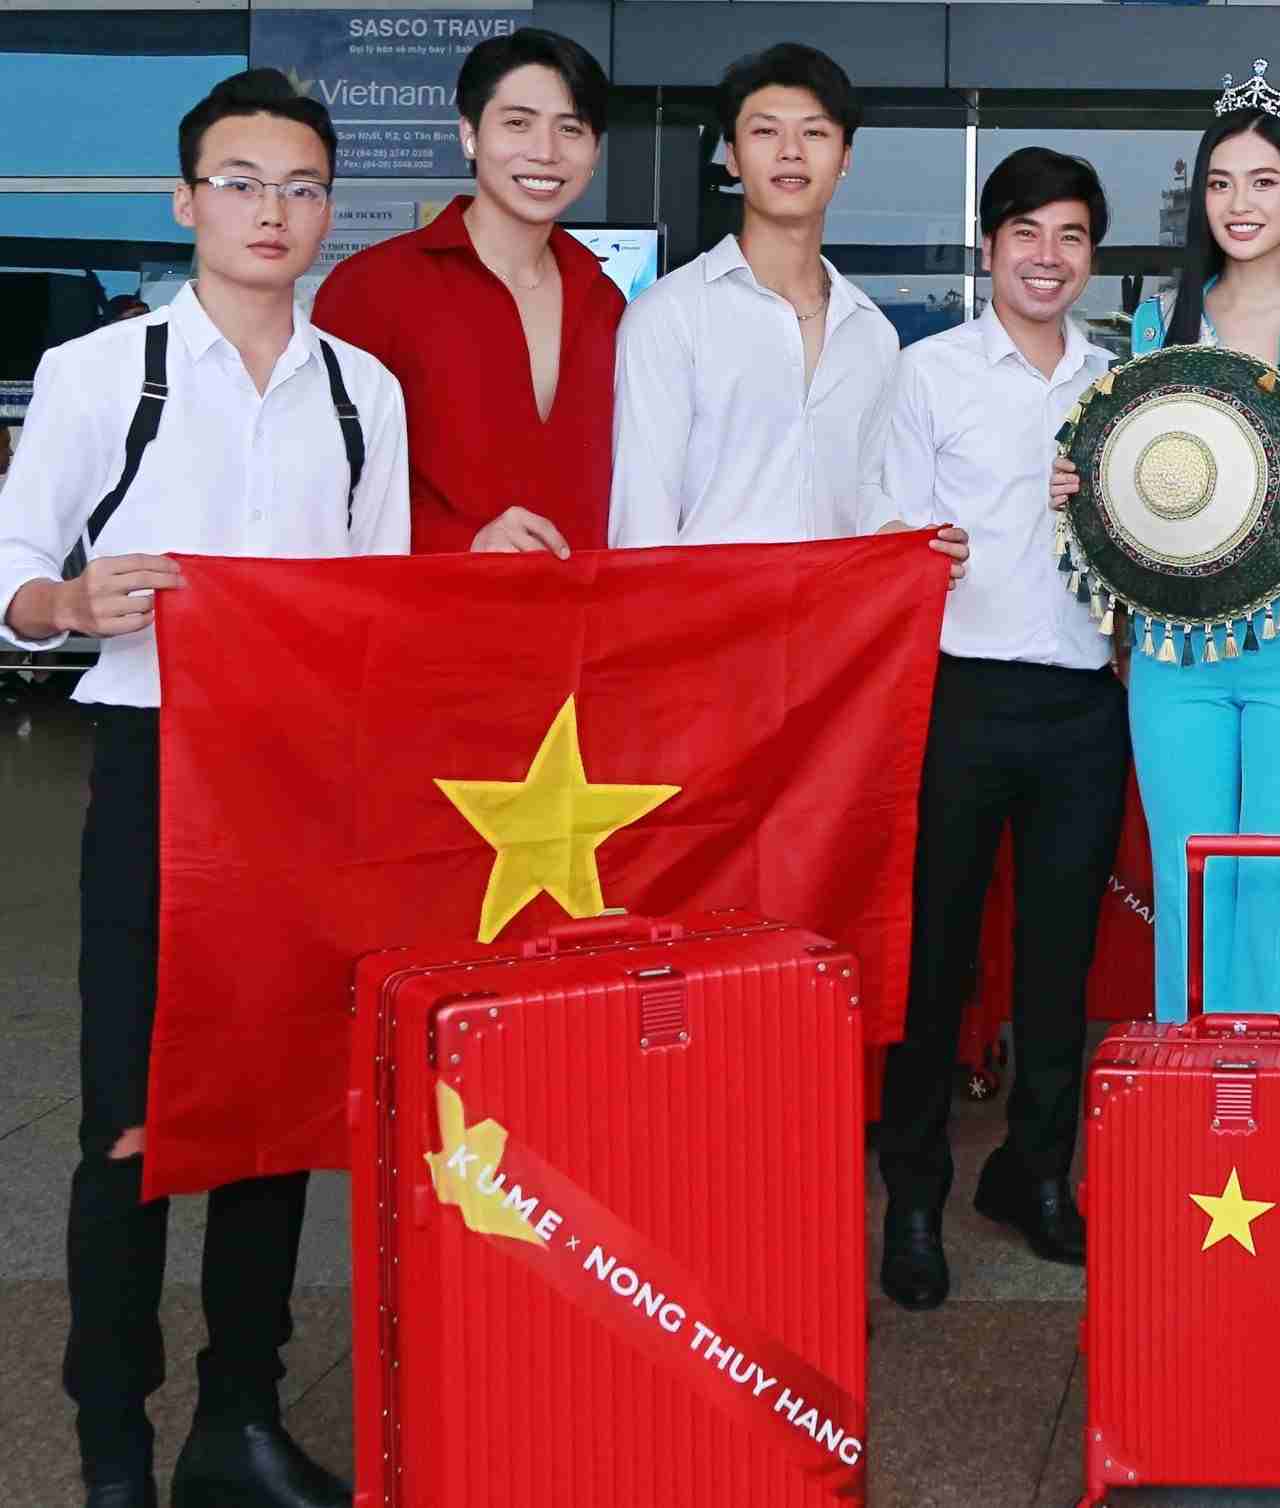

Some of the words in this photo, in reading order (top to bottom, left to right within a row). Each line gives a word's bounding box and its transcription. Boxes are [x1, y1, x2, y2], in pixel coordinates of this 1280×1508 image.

[350, 19, 428, 37] SASCO
[320, 79, 446, 106] Vietnam
[446, 1143, 563, 1241] KUME
[582, 1245, 687, 1333] NONG
[690, 1321, 778, 1397] THUY
[774, 1388, 863, 1466] HANG
